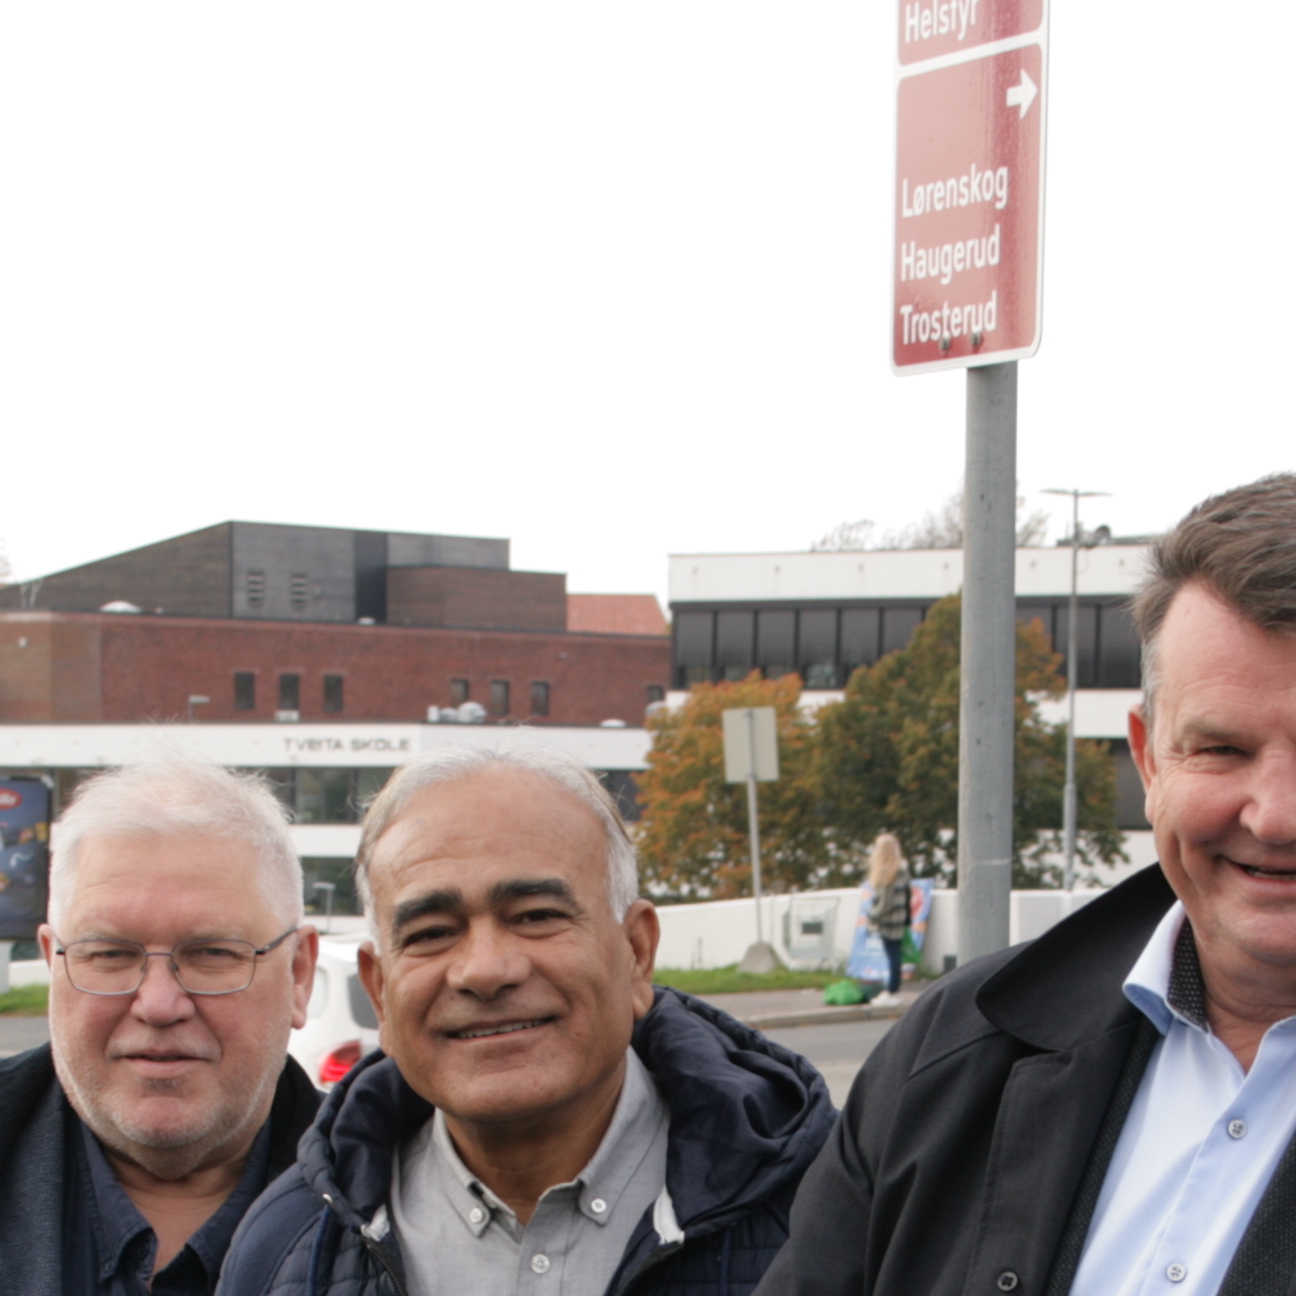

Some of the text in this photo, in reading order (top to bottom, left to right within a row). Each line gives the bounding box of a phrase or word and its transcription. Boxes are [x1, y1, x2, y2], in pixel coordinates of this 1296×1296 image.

[905, 0, 980, 43] Helsfyr
[902, 163, 1008, 218] Lørenskog
[901, 223, 1000, 285] Haugerud
[900, 290, 997, 345] Trosterud
[284, 737, 410, 751] TVEITA SKOLE
